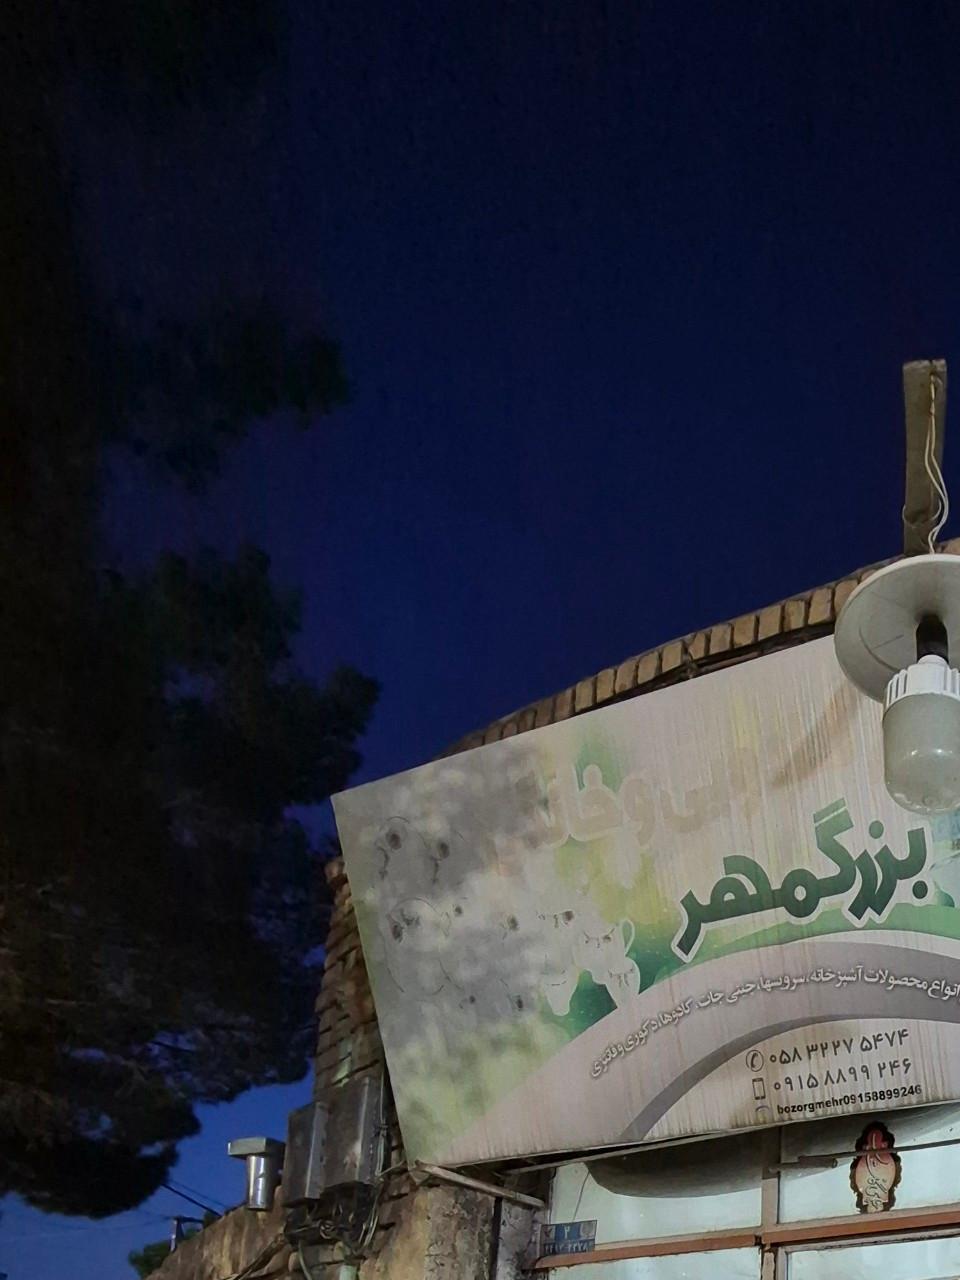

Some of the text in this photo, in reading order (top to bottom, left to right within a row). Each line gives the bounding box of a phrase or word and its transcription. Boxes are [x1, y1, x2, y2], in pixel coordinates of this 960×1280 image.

[674, 798, 928, 956] بزرگمهر
[864, 968, 928, 991] محصولات
[926, 979, 960, 1000] انواع
[769, 1027, 910, 1066] ۰۵۸ ۳۲۲۷ ۵۴۷۴
[773, 1057, 913, 1092] ۰۹۱۵ ۸۸۹۹ ۲۴۶
[776, 1083, 923, 1115] bozorgmehr09158899246
